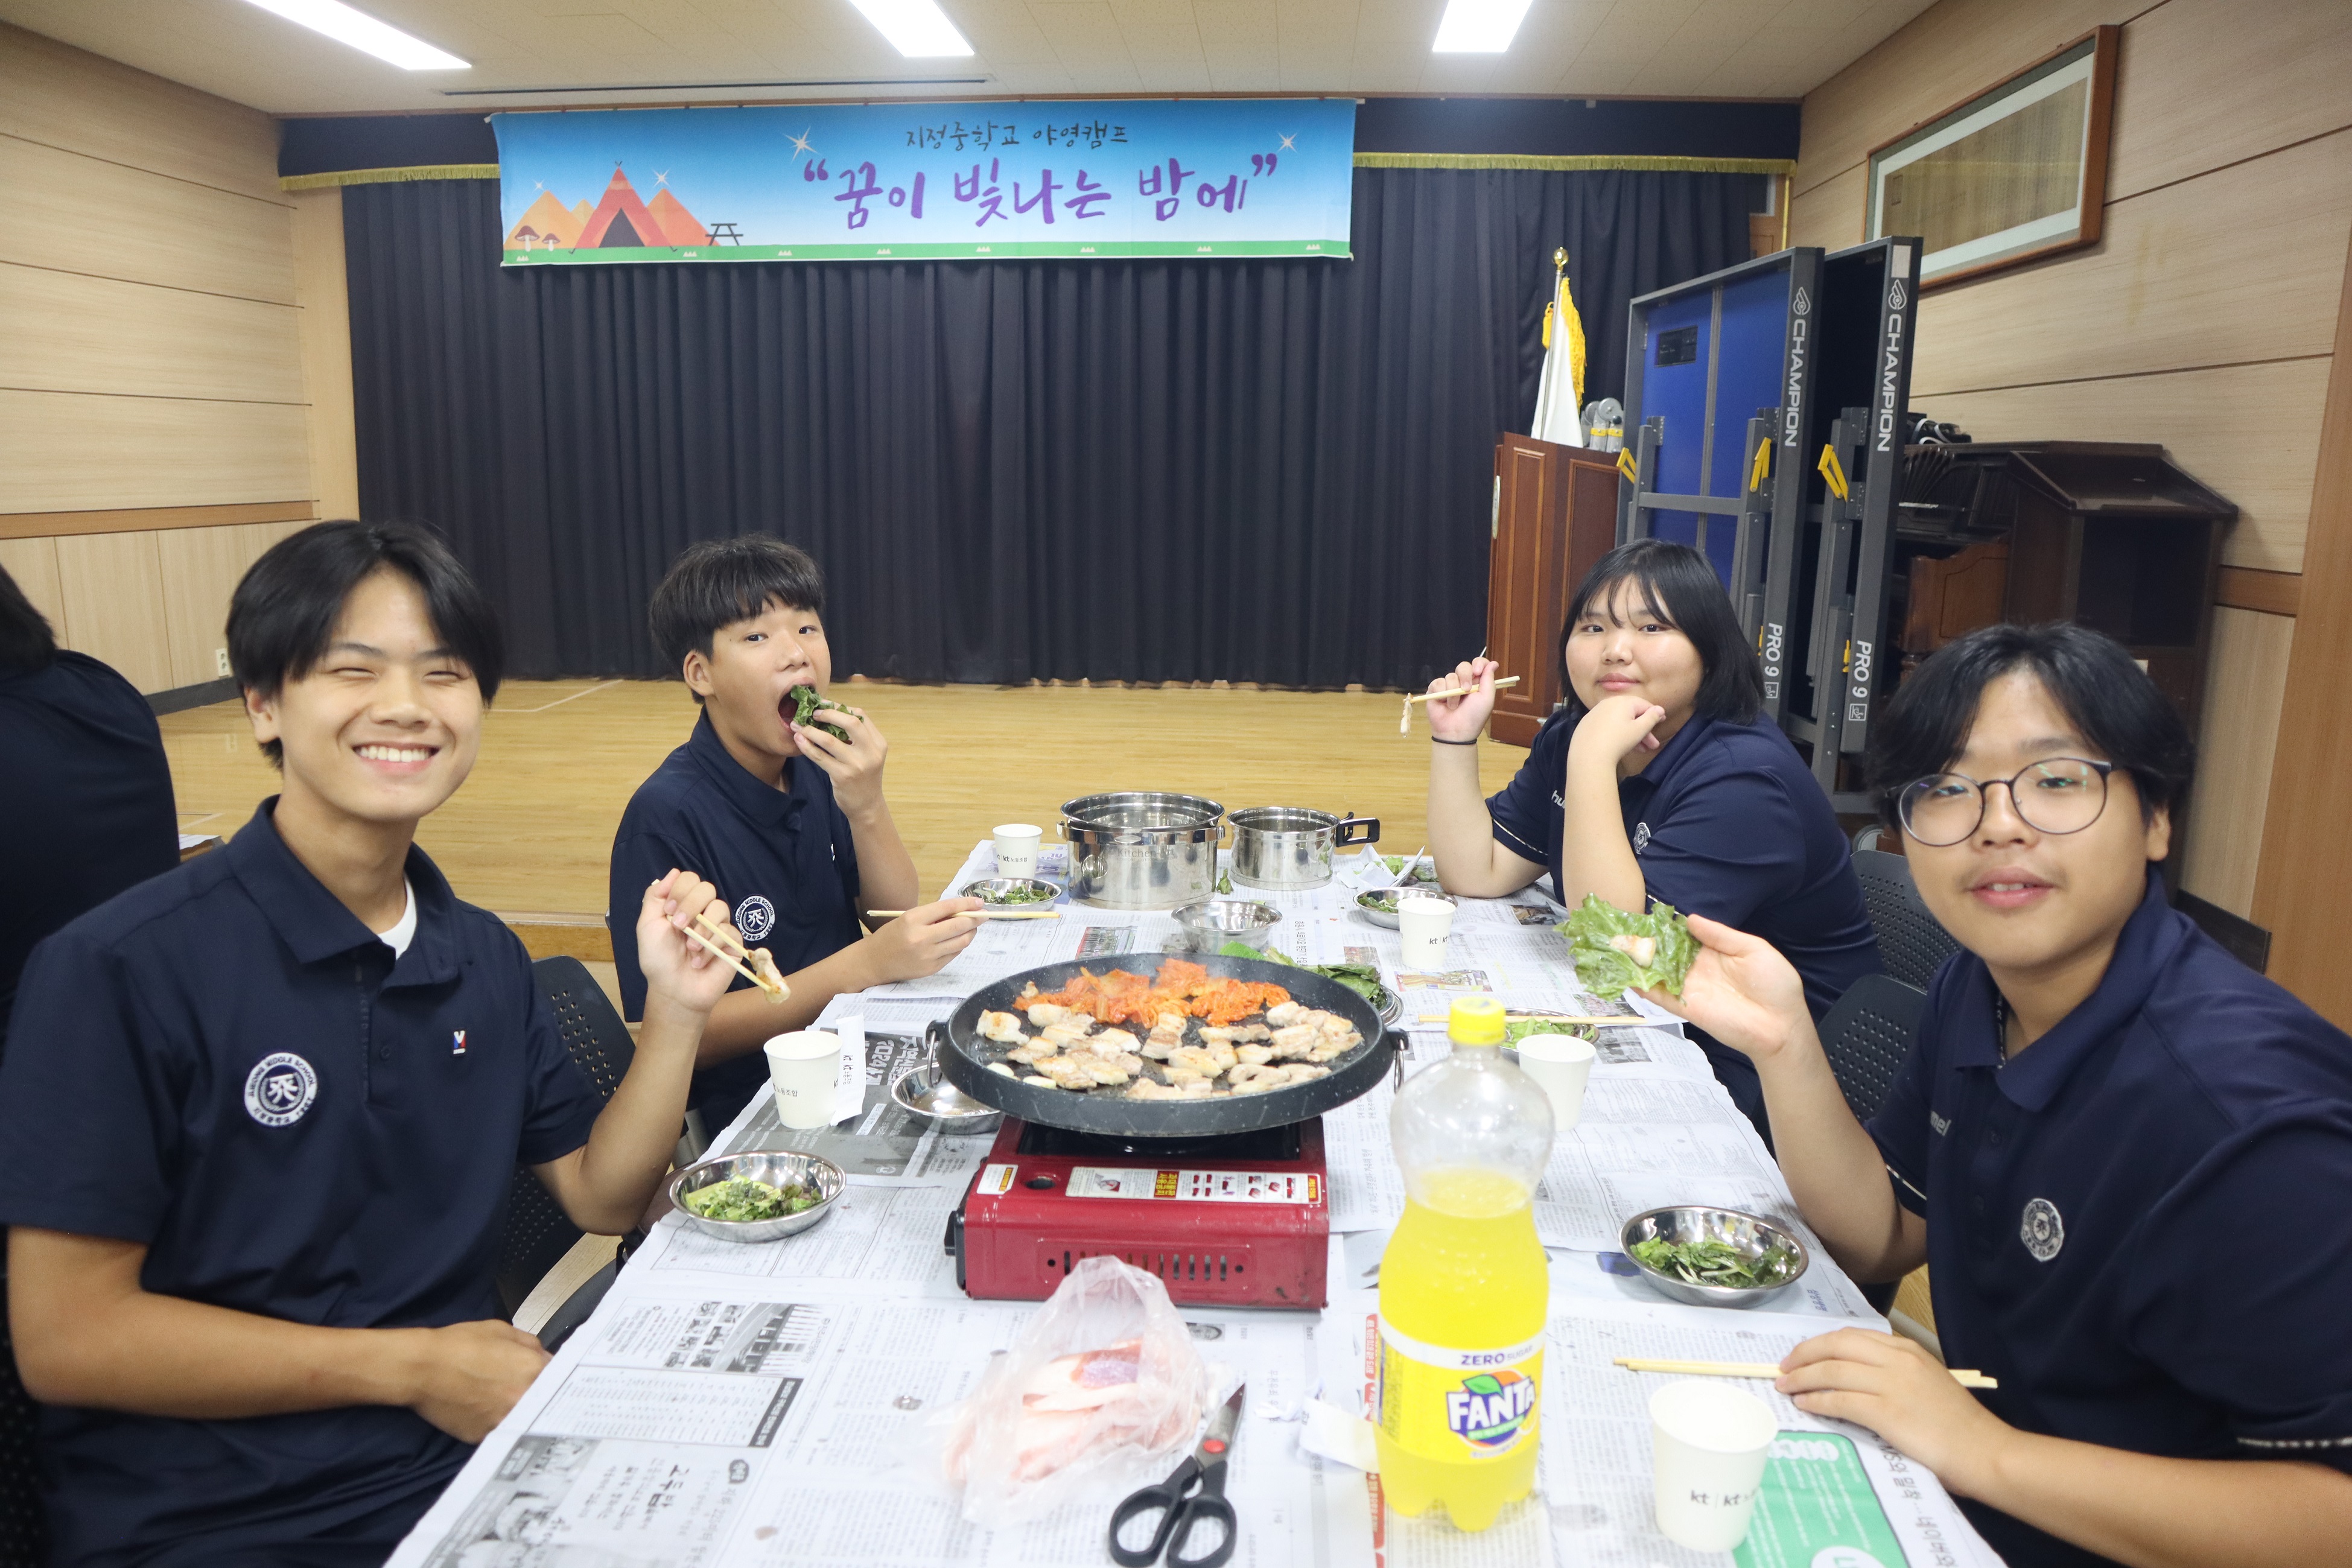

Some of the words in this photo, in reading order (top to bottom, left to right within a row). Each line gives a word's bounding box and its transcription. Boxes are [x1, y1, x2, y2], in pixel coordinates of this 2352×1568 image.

[905, 120, 1020, 152] 지정중학교
[1032, 119, 1130, 150] 야영캠프
[953, 156, 1112, 227] 빛나는
[1784, 317, 1807, 448] CHAMPION
[1876, 313, 1902, 452] CHAMPION
[1766, 622, 1784, 662] PRO
[1852, 640, 1873, 682] PRO
[1764, 665, 1780, 678] 9
[1851, 685, 1869, 699] 9
[1116, 847, 1175, 858] Kitchen-Art
[761, 899, 774, 917] SCHOOL
[1429, 937, 1438, 945] kt
[776, 1086, 798, 1097] 노동조합
[1461, 1352, 1505, 1366] ZERO
[1506, 1345, 1533, 1361] SUGAR
[1446, 1376, 1536, 1432] FANTA
[1691, 1489, 1709, 1505] kt
[1723, 1494, 1741, 1506] kt
